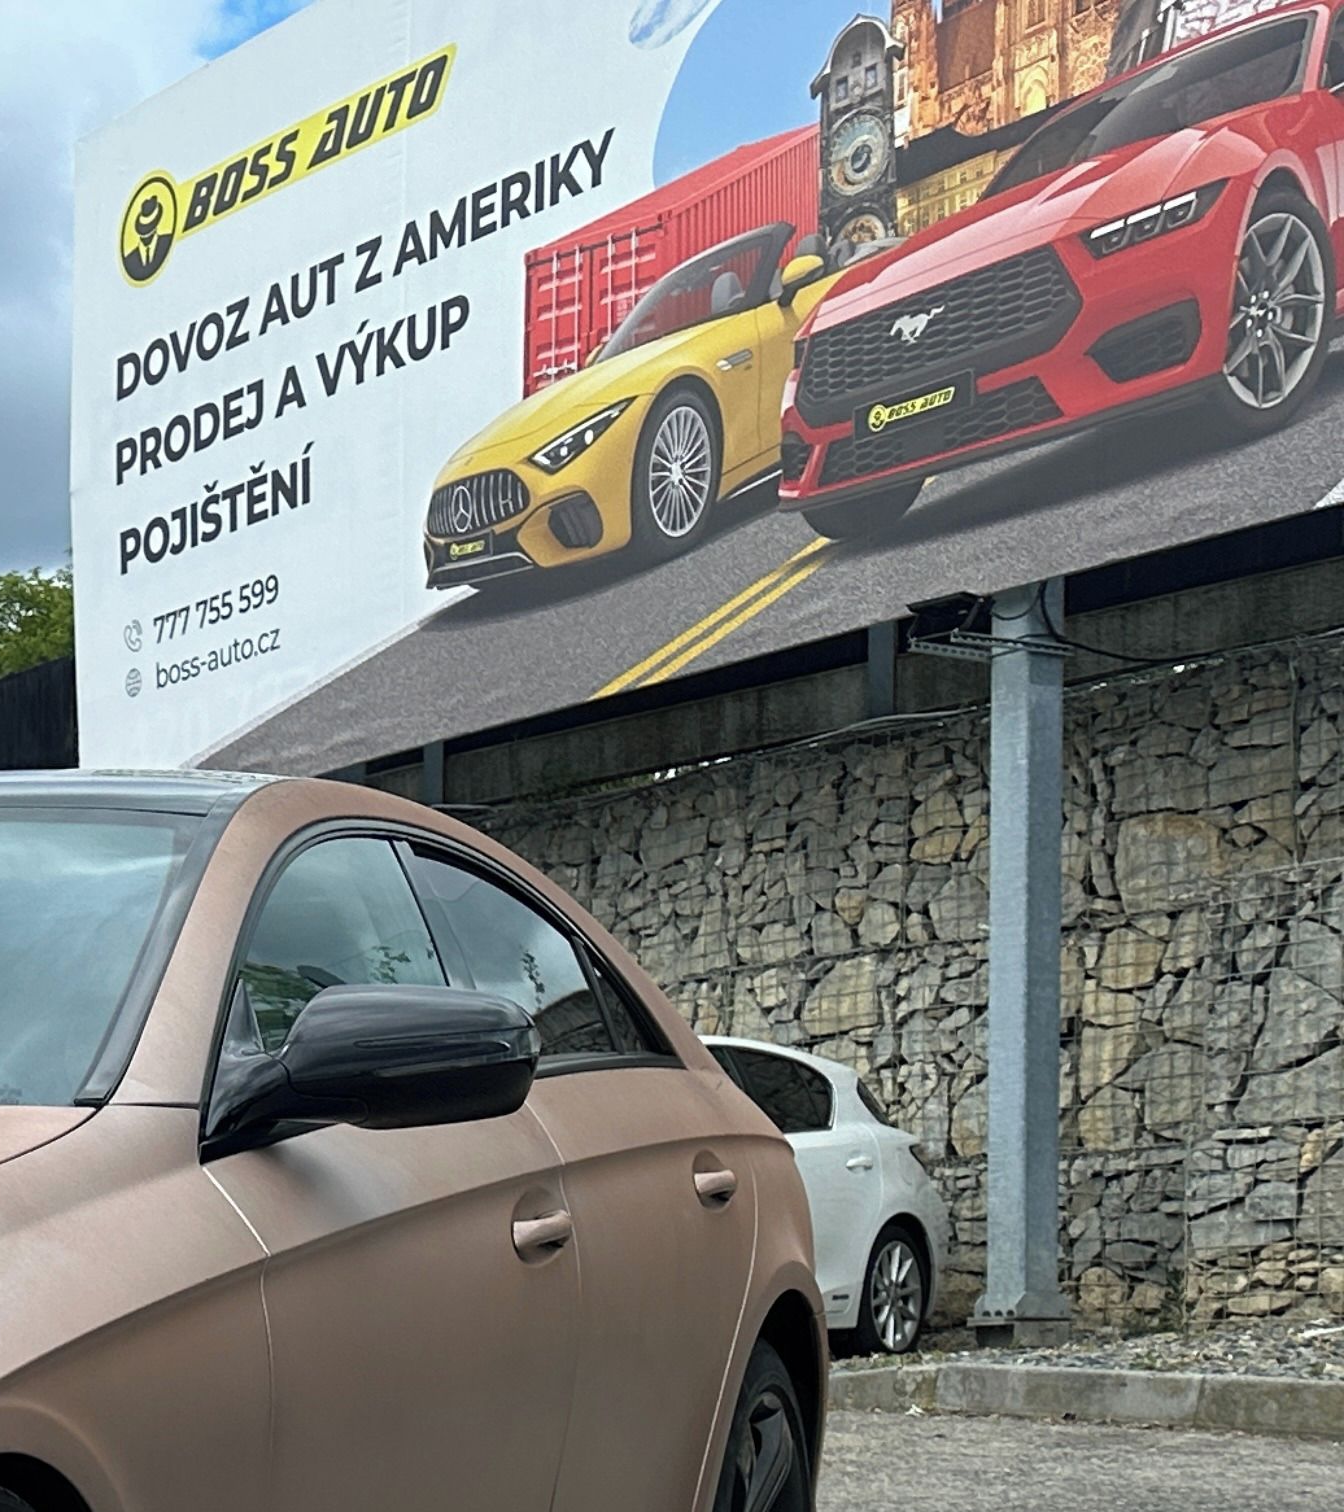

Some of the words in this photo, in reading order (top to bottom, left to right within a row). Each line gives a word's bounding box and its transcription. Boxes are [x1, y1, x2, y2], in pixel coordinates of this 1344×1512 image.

[182, 129, 300, 234] BOSS
[306, 54, 448, 170] AUTO
[116, 296, 250, 402] DOVOZ
[258, 252, 344, 336] AUT
[354, 236, 383, 293] Z
[393, 127, 616, 277] AMERIKY
[116, 378, 264, 486] PRODEJ
[275, 365, 307, 419] A
[316, 294, 471, 398] VÝKUP
[119, 441, 315, 576] POJIŠTĚNÍ
[153, 605, 191, 644] 777
[195, 590, 233, 630] 755
[238, 574, 279, 613] 599
[155, 628, 281, 689] boss-auto.cz
